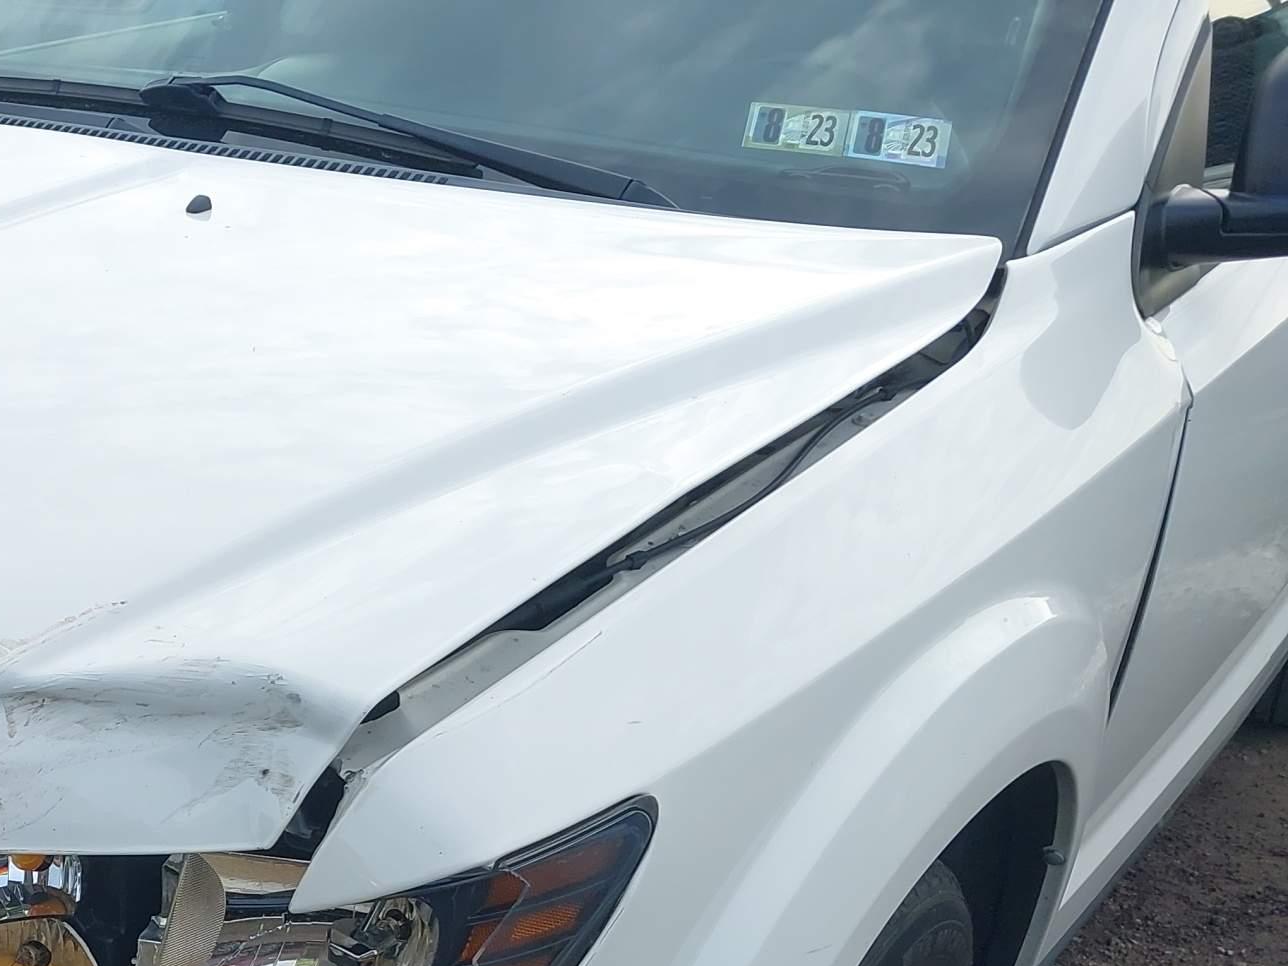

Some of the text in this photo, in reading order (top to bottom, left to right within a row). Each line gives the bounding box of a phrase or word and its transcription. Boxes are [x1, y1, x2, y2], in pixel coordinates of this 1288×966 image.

[763, 108, 785, 142] 8
[806, 114, 837, 147] 23
[864, 118, 885, 153] 8
[907, 124, 938, 157] 23
